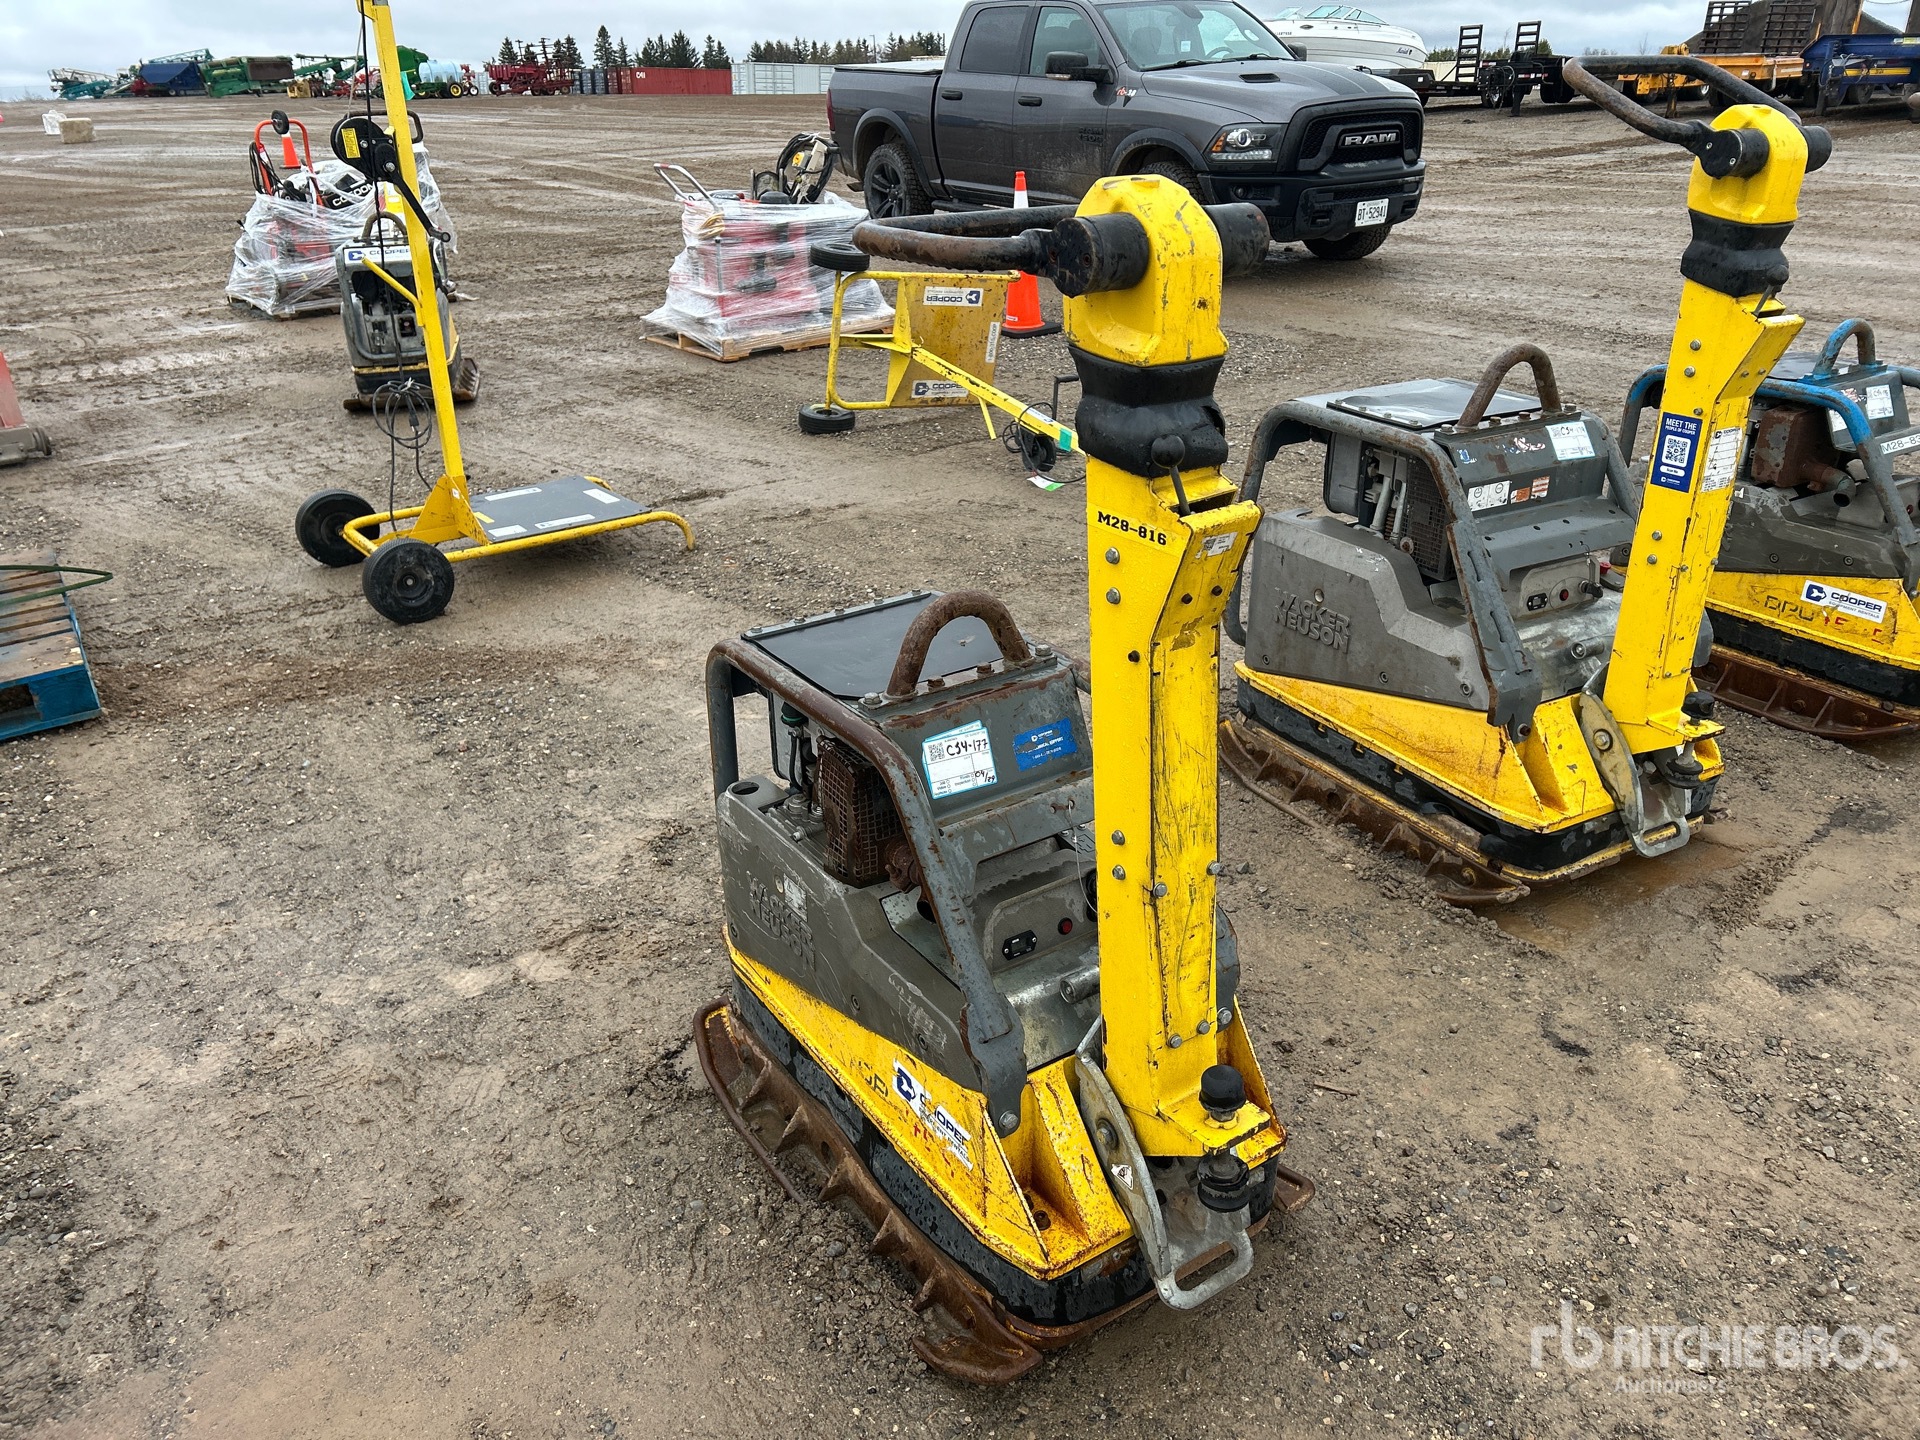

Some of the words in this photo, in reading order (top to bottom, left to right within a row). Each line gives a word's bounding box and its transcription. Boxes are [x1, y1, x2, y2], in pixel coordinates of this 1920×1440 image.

[1344, 132, 1397, 146] RAM
[926, 295, 963, 303] COOPER
[1665, 418, 1684, 428] MEET
[1685, 421, 1698, 431] THE
[1097, 511, 1167, 546] M28-816
[1274, 587, 1350, 636] WACKER
[1830, 592, 1883, 612] COOPER
[1274, 605, 1350, 654] NEUSON
